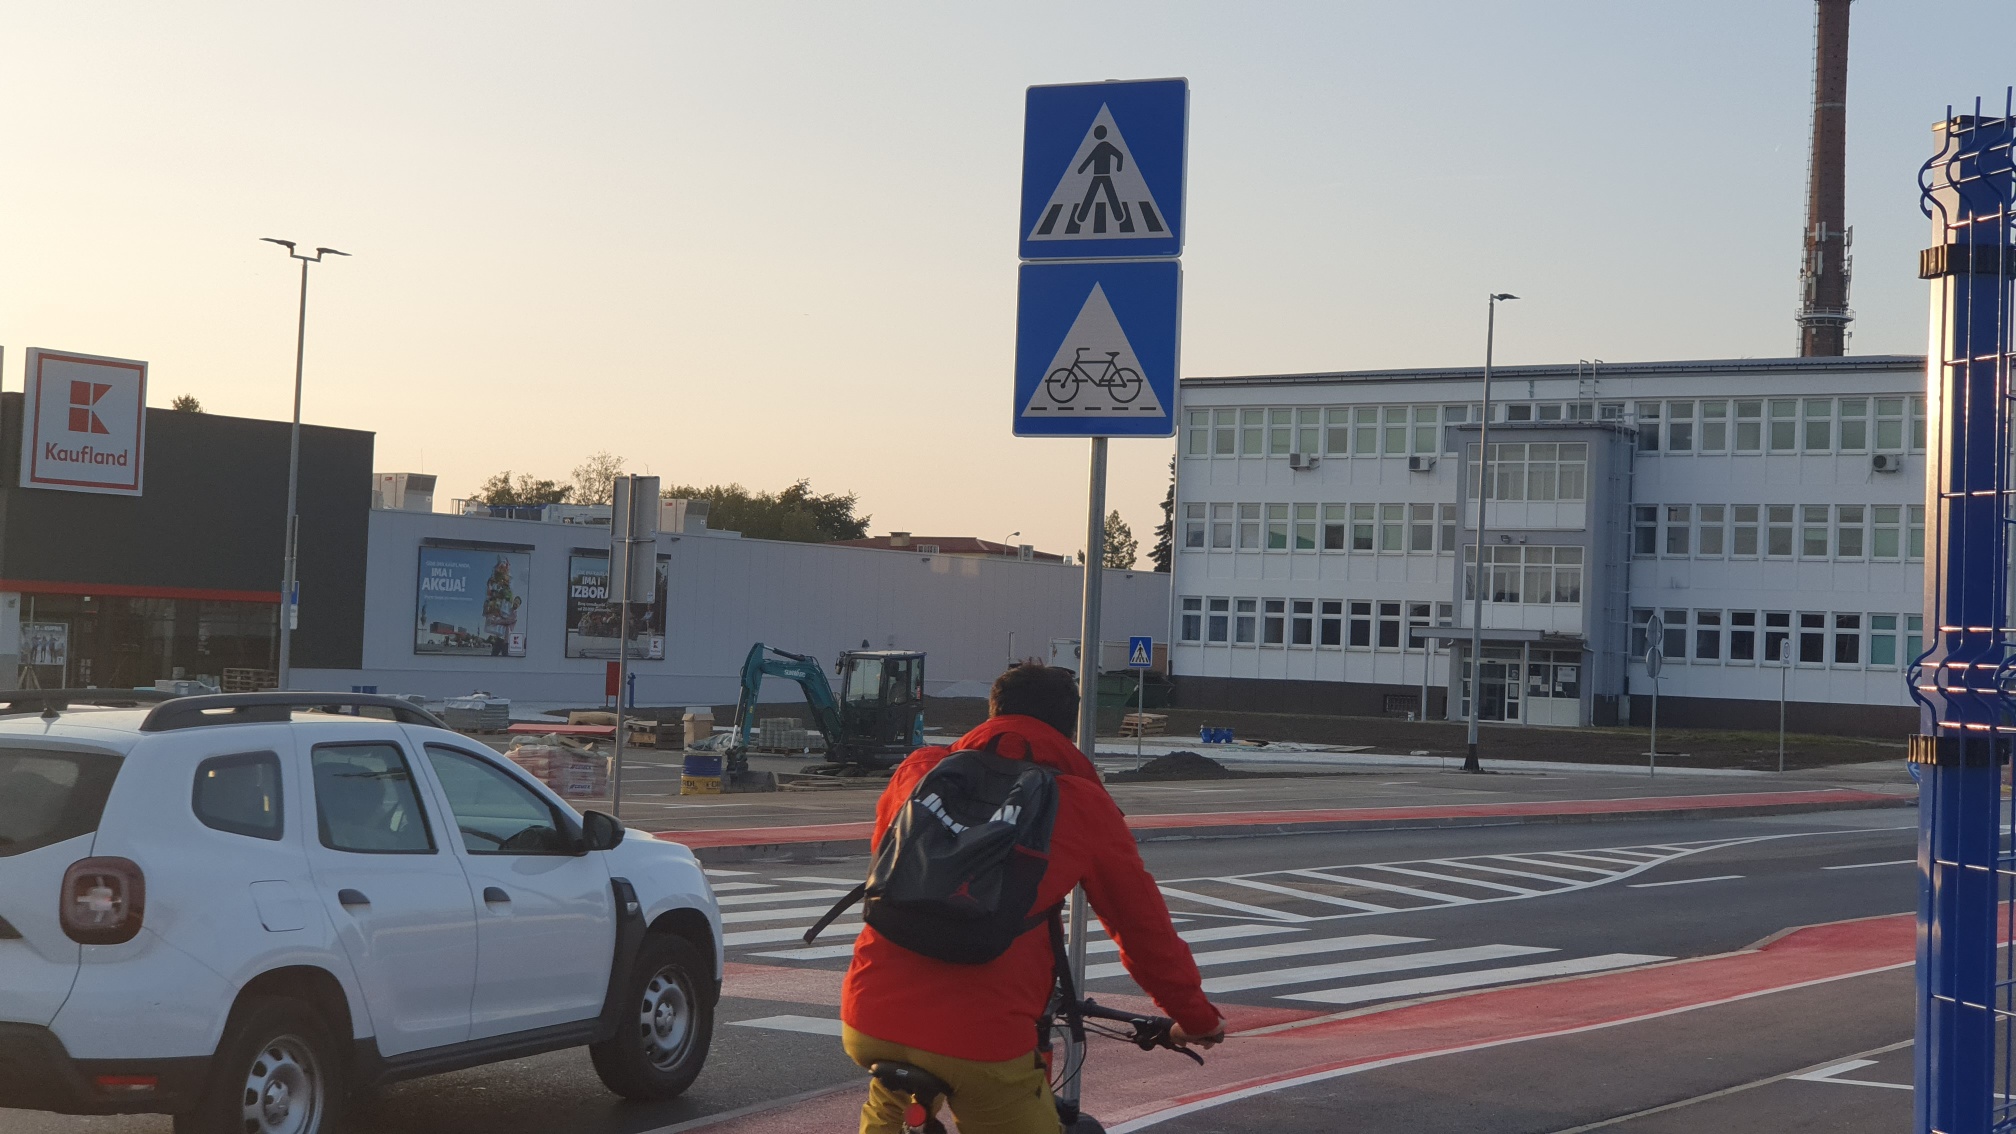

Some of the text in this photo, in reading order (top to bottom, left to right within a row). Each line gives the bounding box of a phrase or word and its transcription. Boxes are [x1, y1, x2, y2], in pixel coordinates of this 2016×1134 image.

[45, 441, 128, 467] Kaufland
[431, 567, 447, 577] IMA
[422, 576, 466, 593] AKCIJA!
[582, 576, 596, 585] IMA
